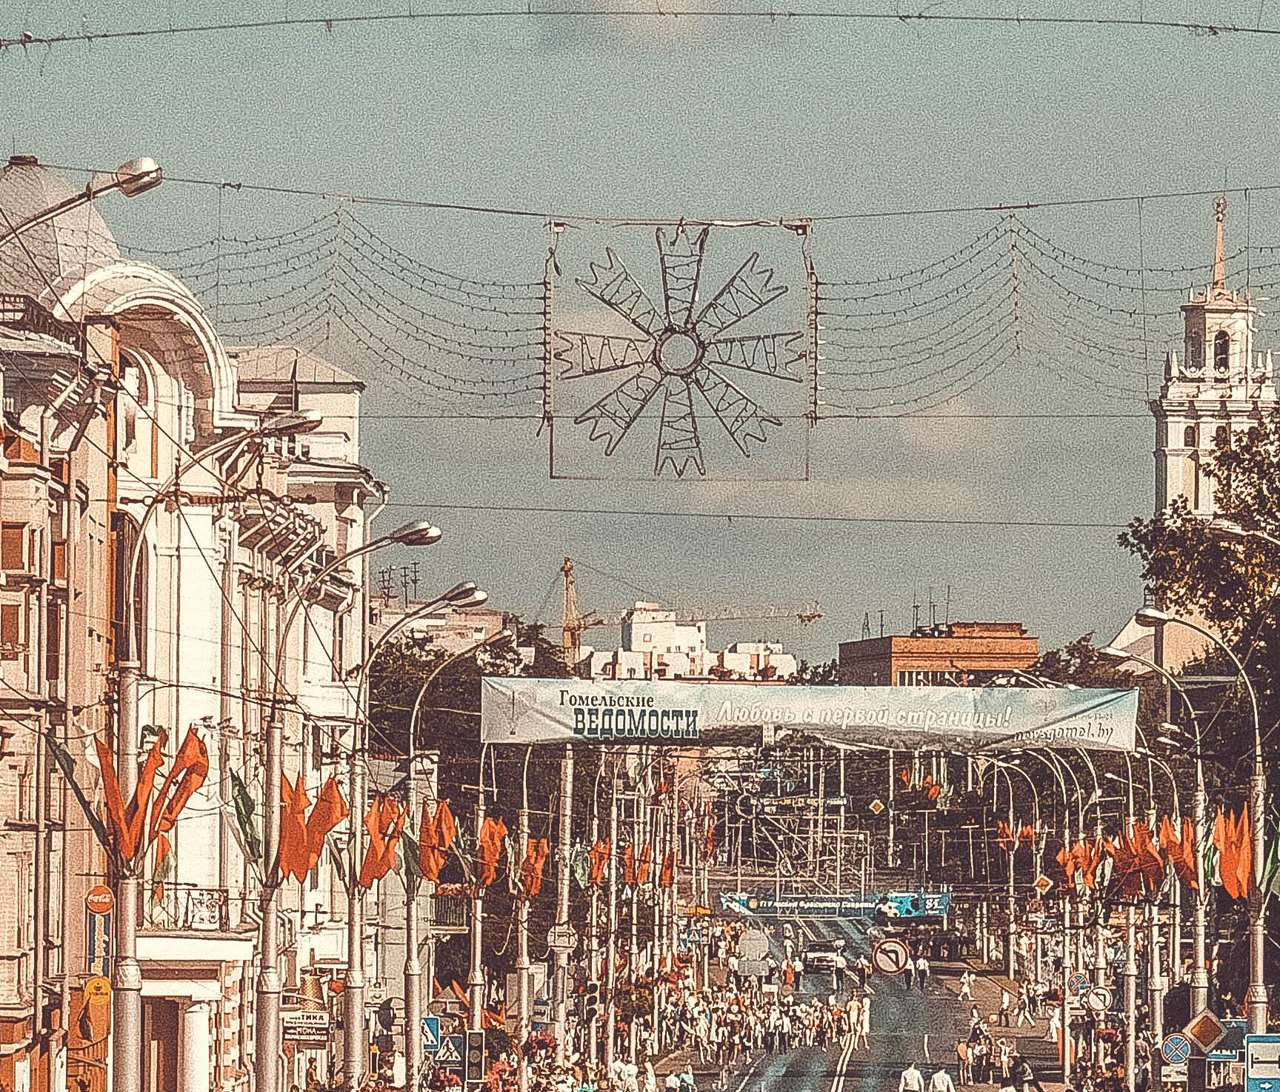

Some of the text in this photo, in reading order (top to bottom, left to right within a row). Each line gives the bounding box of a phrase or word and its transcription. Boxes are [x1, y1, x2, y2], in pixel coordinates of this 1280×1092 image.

[559, 690, 654, 707] Гомельские
[573, 708, 698, 739] ВЕДОМОСТИ
[716, 701, 795, 722] Любовь
[820, 705, 889, 729] первой
[896, 706, 1012, 732] страницы!
